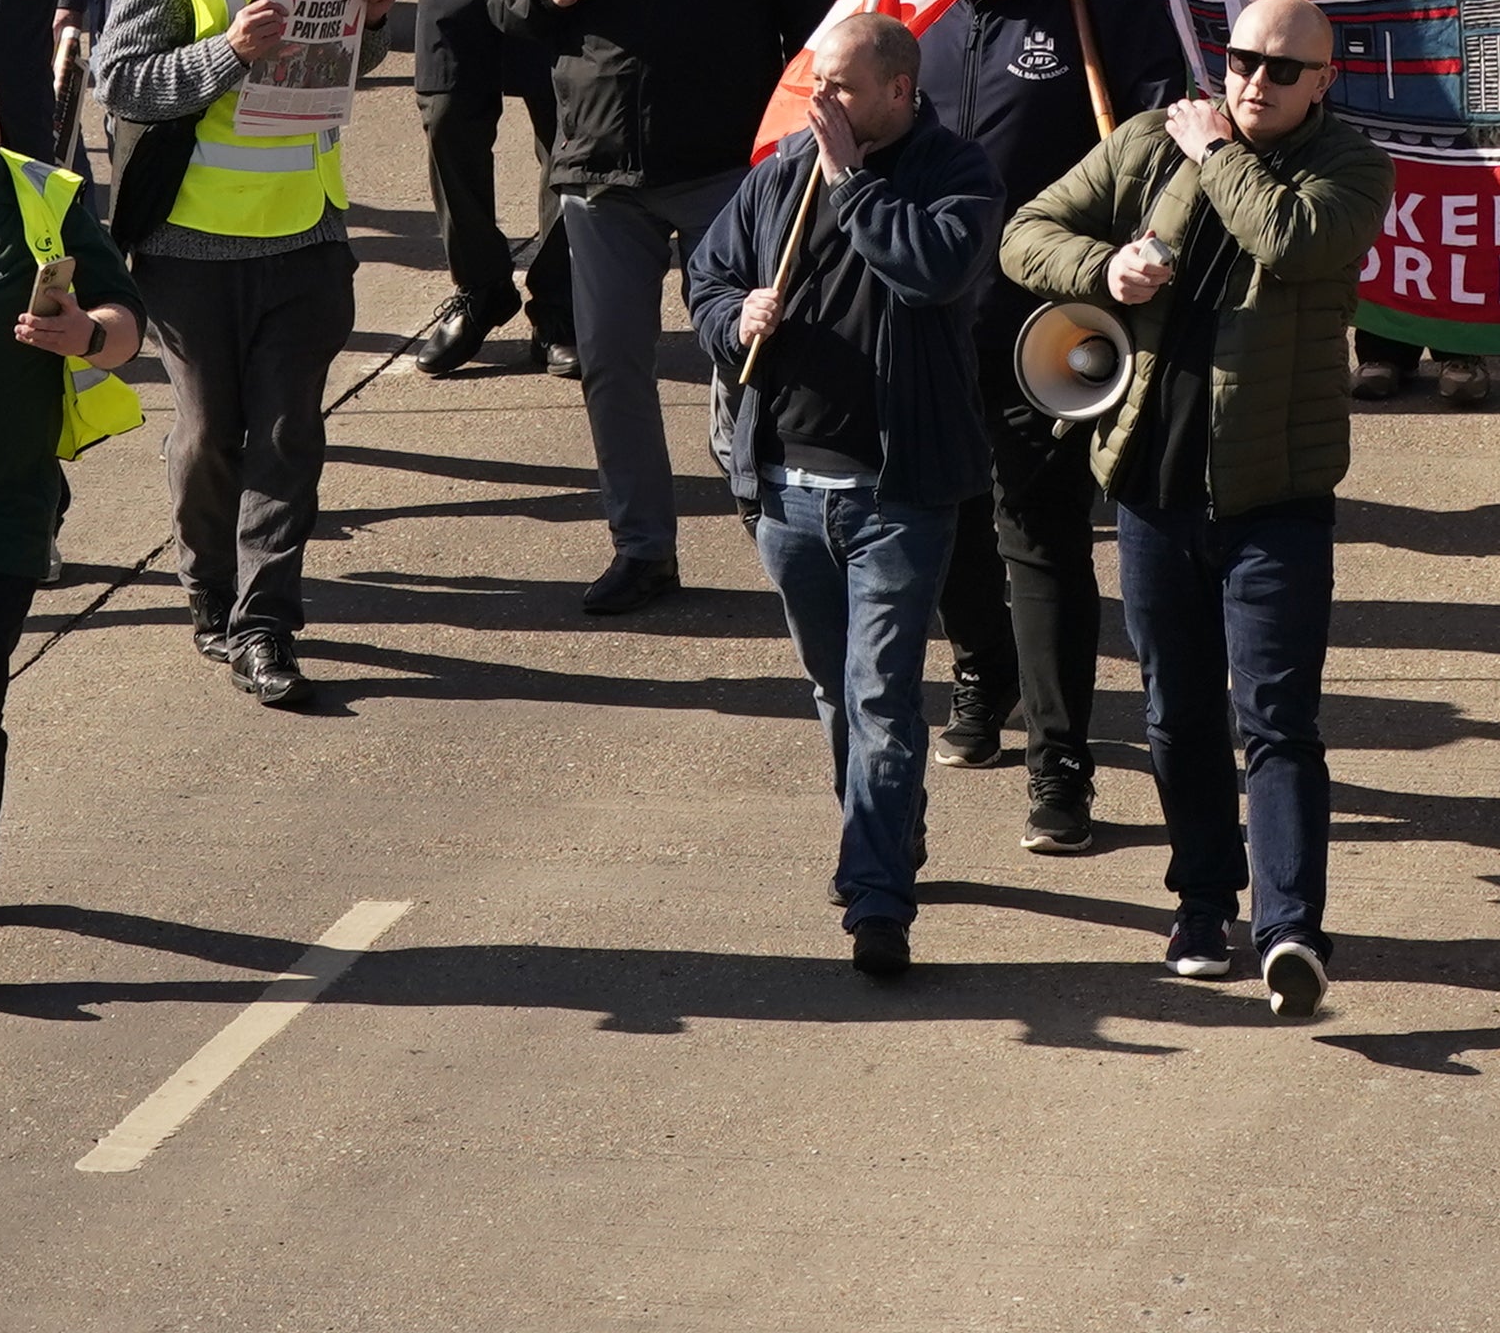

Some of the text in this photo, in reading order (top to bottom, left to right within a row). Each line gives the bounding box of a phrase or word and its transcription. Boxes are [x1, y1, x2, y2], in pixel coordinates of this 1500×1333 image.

[294, 3, 305, 17] A
[291, 19, 342, 39] PAY RISE
[1026, 56, 1052, 65] RMT
